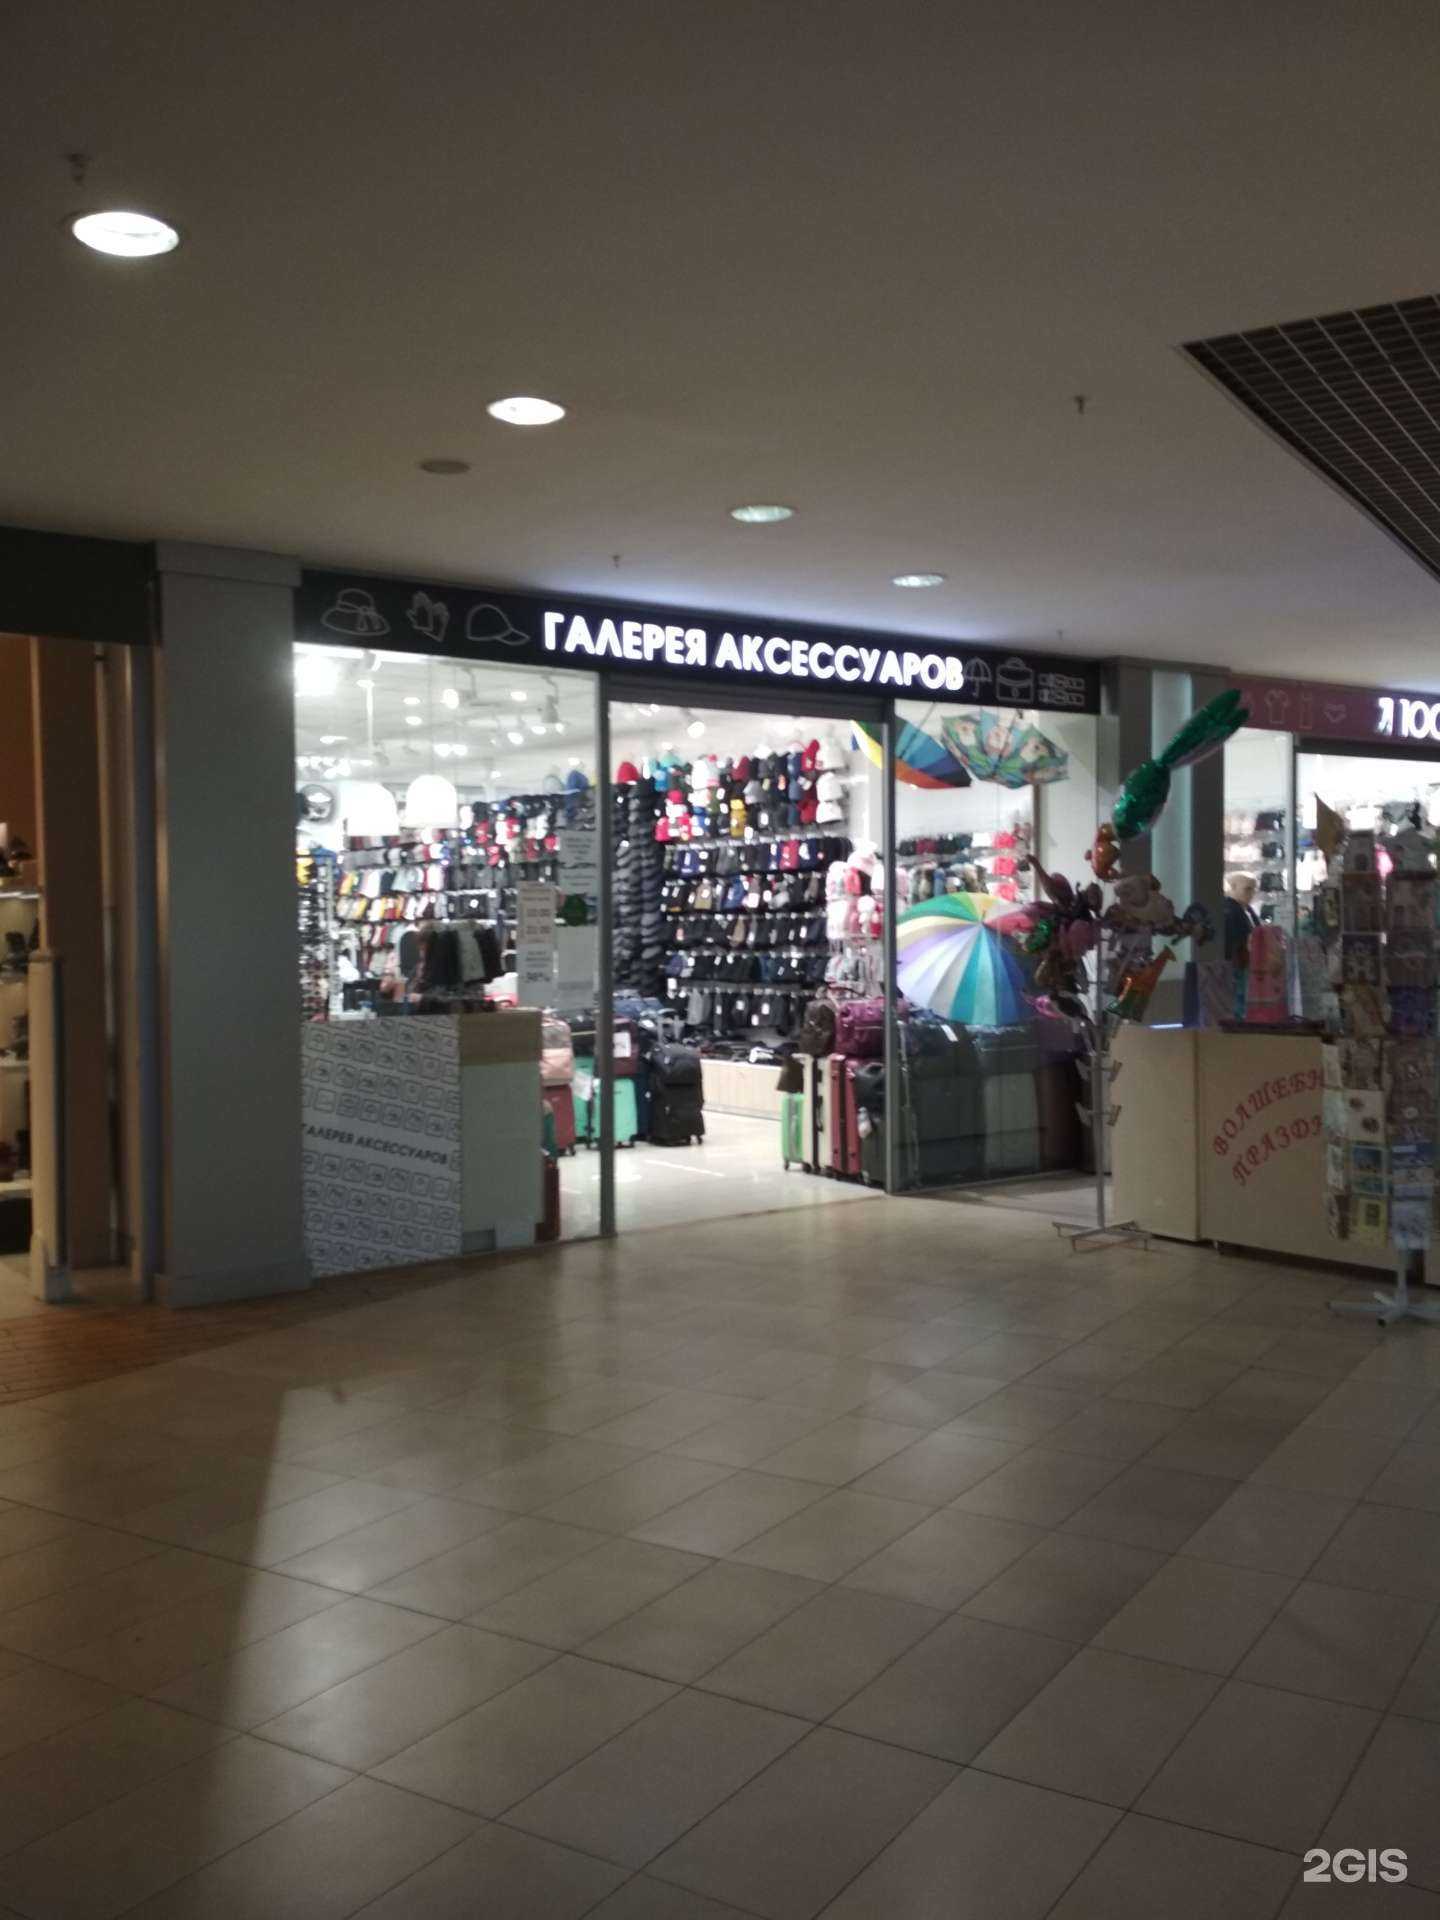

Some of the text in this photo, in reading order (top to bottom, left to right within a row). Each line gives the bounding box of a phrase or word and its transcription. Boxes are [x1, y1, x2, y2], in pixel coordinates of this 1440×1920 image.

[543, 611, 965, 692] ГАЛЕРЕЯ АКСЕССУАРОВ
[355, 1135, 448, 1165] АКСЕССУАРОВ
